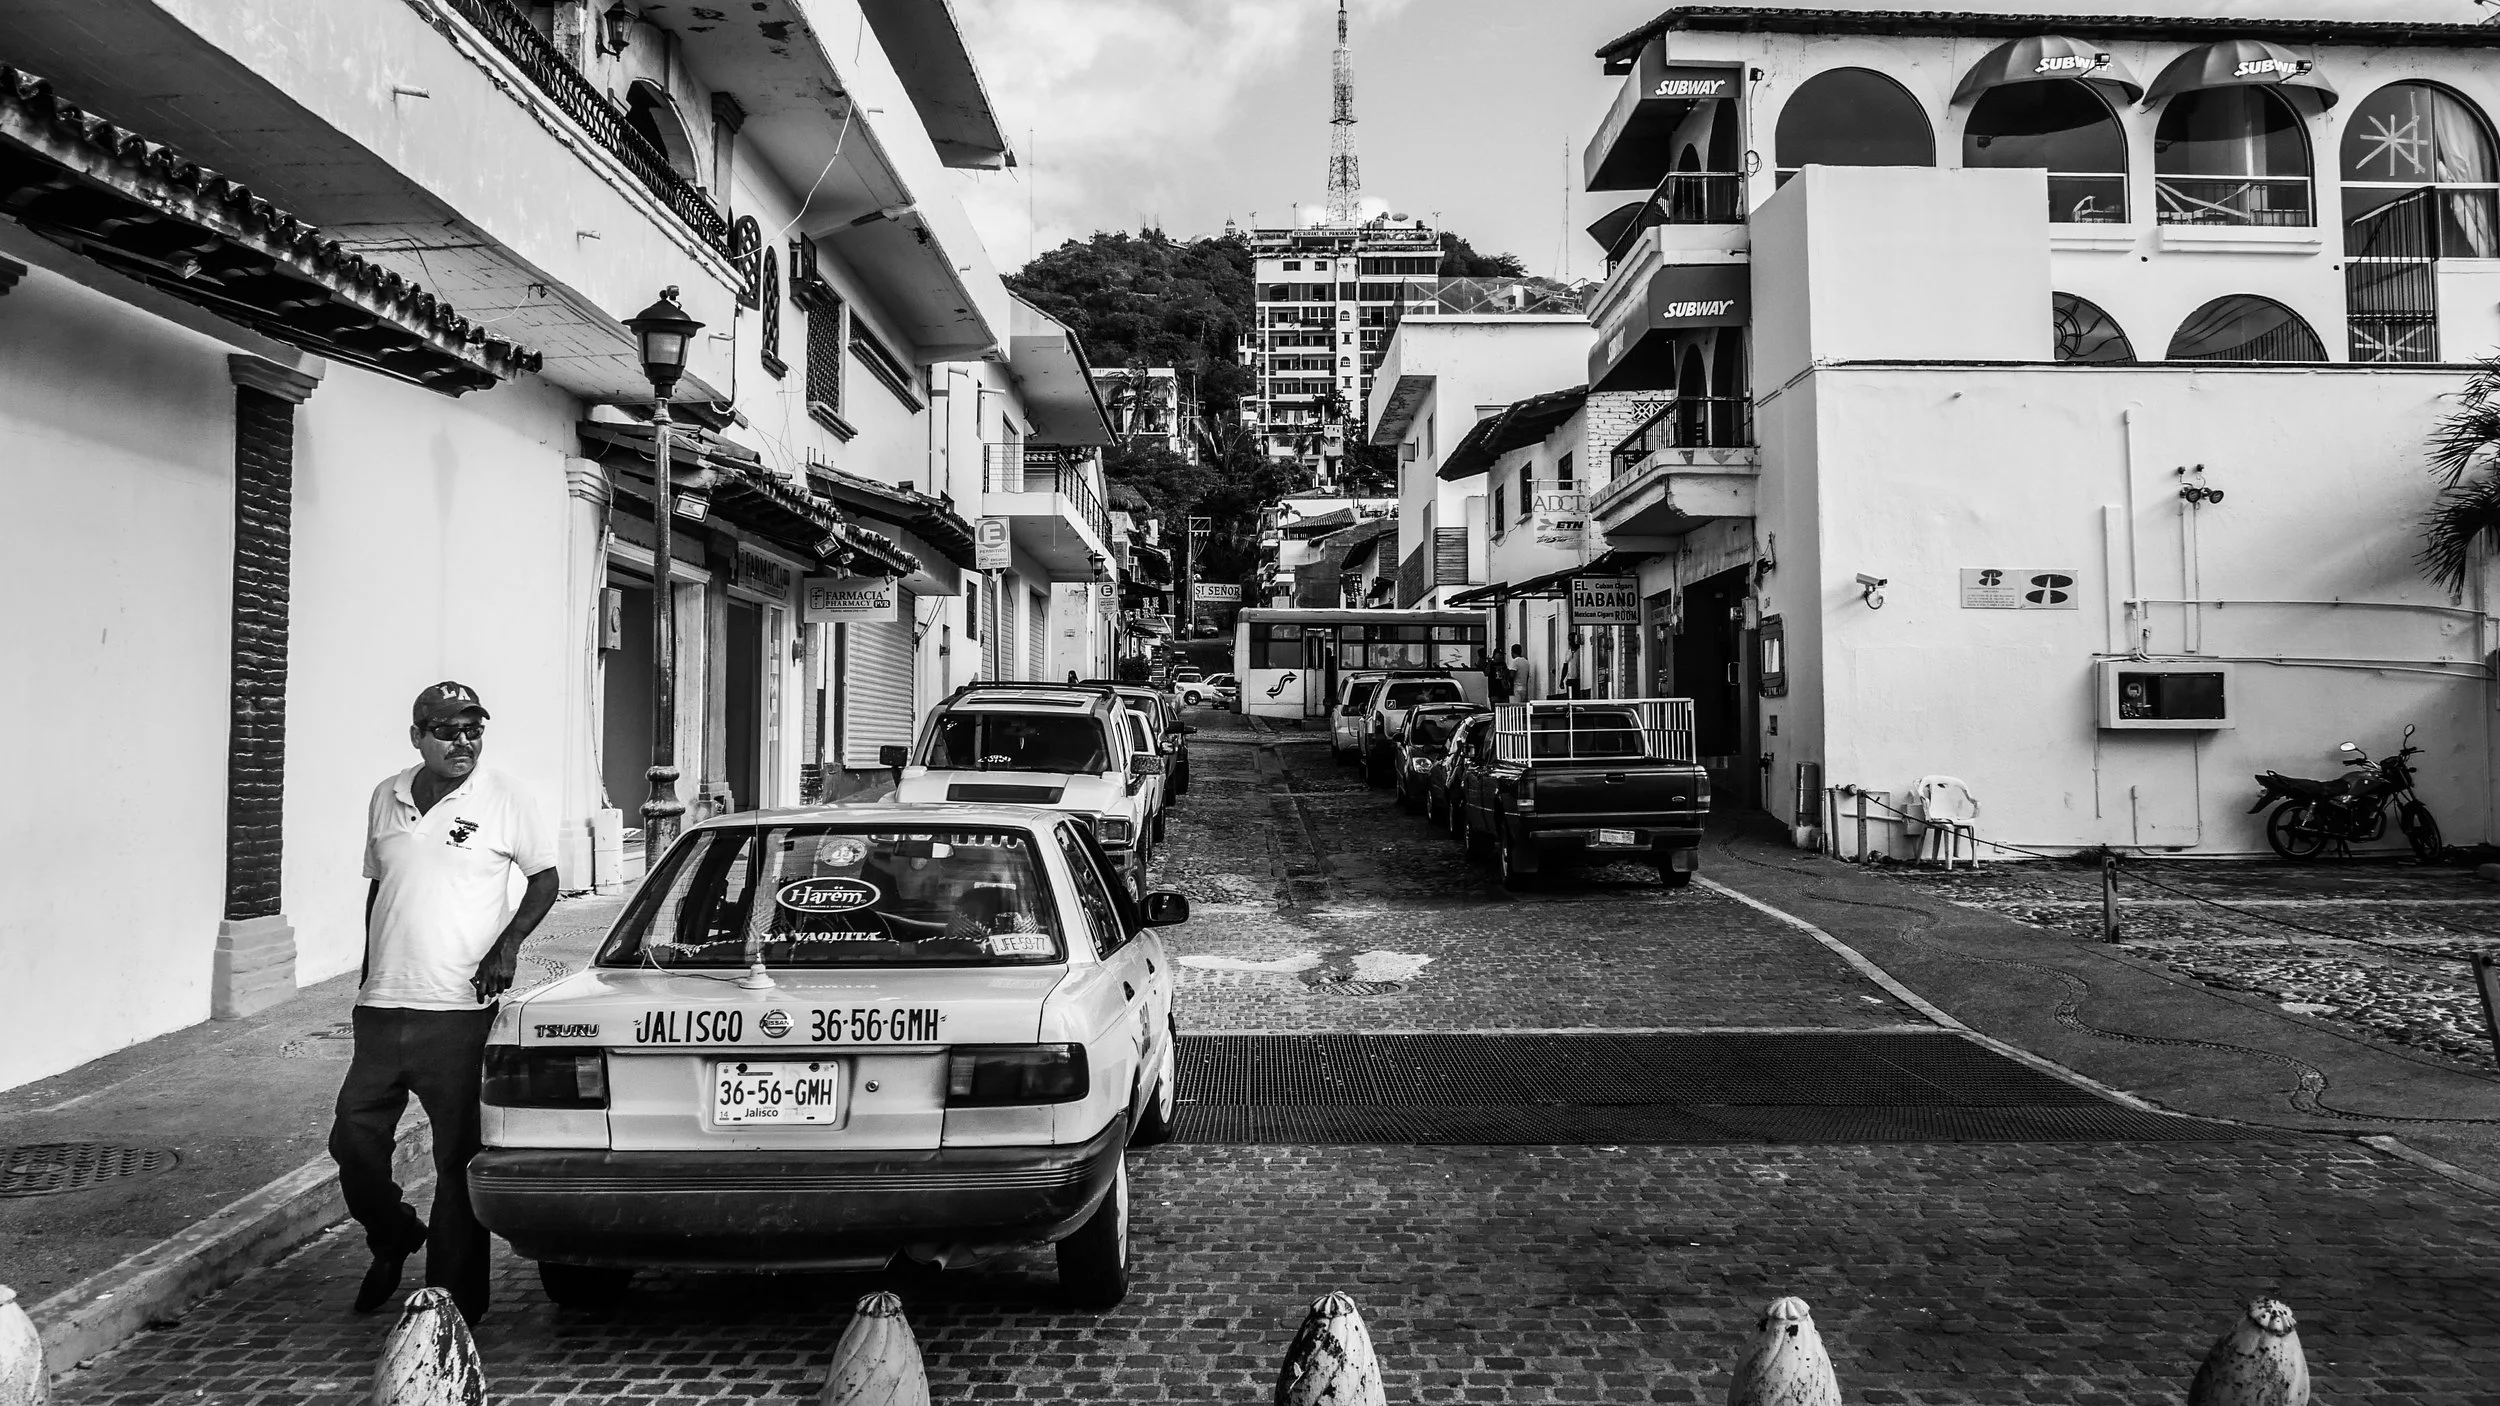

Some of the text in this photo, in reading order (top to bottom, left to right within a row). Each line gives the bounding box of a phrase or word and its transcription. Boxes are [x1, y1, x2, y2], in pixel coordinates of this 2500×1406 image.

[2233, 58, 2310, 77] SUBWA
[1655, 79, 1726, 96] SUBWAY
[1662, 299, 1735, 319] SUBWAY
[1556, 520, 1585, 529] ETN
[983, 523, 1003, 545] E
[1195, 584, 1240, 596] SI SEÑOR
[1574, 580, 1589, 591] EL
[825, 590, 884, 601] FARMACIA
[1574, 591, 1636, 608] HABANO
[875, 600, 890, 608] PVR
[1597, 611, 1614, 619] Cigars
[440, 685, 472, 701] LA
[761, 931, 887, 944] LA VAQUITA
[534, 1024, 599, 1038] TSURU
[636, 1010, 743, 1043] JALISCO
[719, 1078, 833, 1105] 36-56-GMH
[745, 1107, 779, 1118] Jalisco
